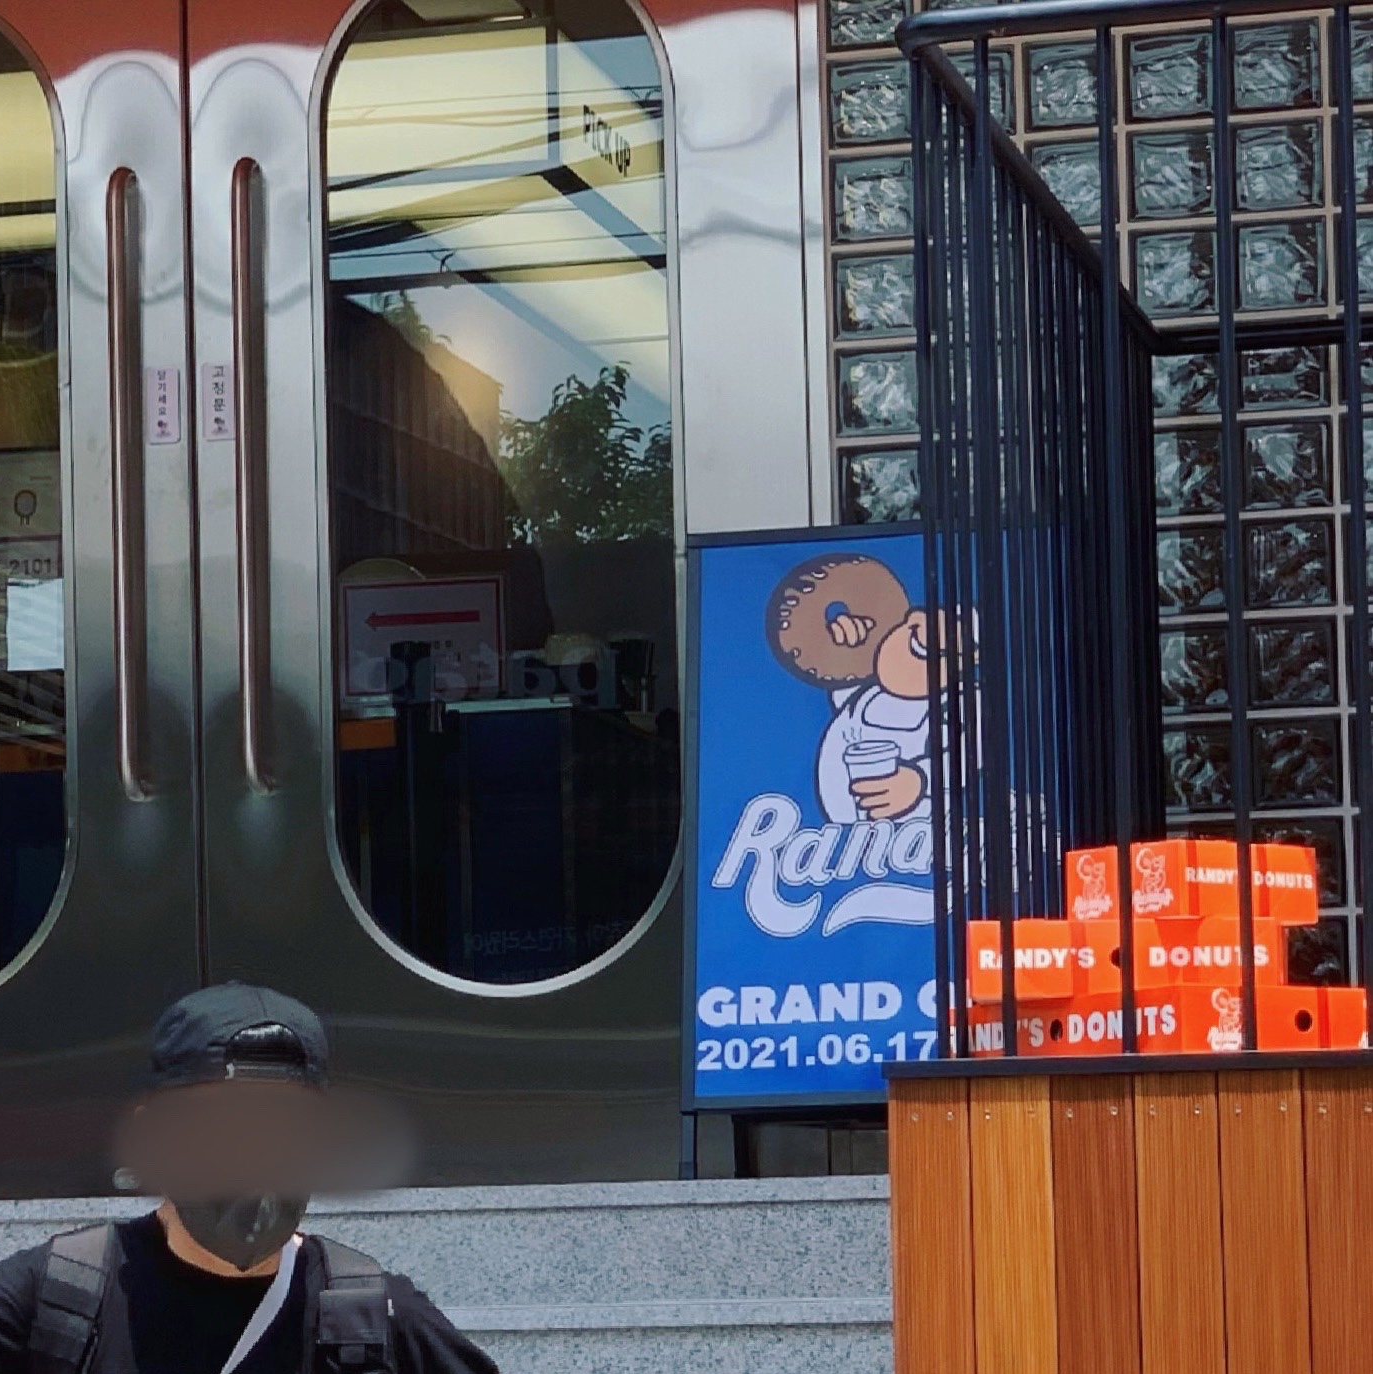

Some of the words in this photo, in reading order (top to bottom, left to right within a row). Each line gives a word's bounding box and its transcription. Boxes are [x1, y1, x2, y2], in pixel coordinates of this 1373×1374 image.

[212, 365, 226, 412] 고정문
[1185, 867, 1238, 885] RANDY'
[1253, 870, 1314, 889] DONUTS
[697, 981, 902, 1027] GRAND
[696, 1030, 940, 1071] 2021.06.17
